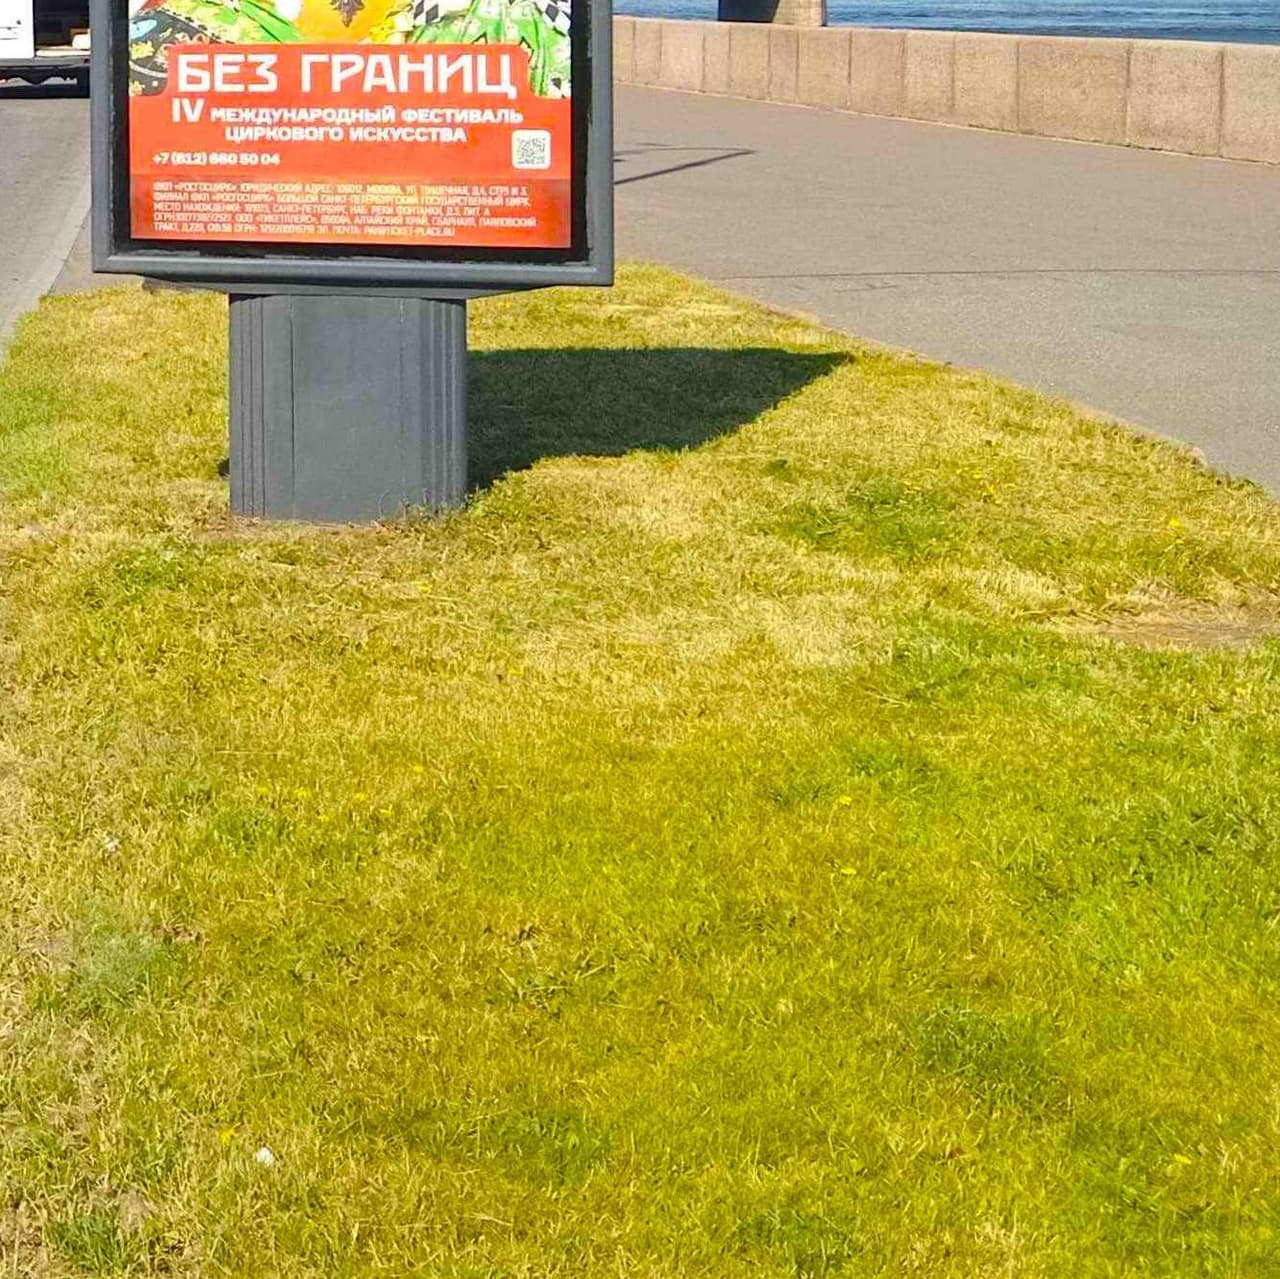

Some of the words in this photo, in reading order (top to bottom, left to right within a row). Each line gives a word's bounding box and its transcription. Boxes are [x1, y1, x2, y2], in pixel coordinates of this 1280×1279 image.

[177, 53, 279, 94] БЕЗ
[301, 53, 518, 100] ГРАНИЦ
[171, 97, 205, 123] IV
[210, 105, 396, 126] МЕЖДУНАРОДНЫЙ
[401, 108, 525, 124] ФЕСТИВАЛЬ
[225, 126, 345, 144] ЦИРКОВОГО
[349, 126, 468, 143] ИСКУССТВА
[152, 153, 169, 165] +7
